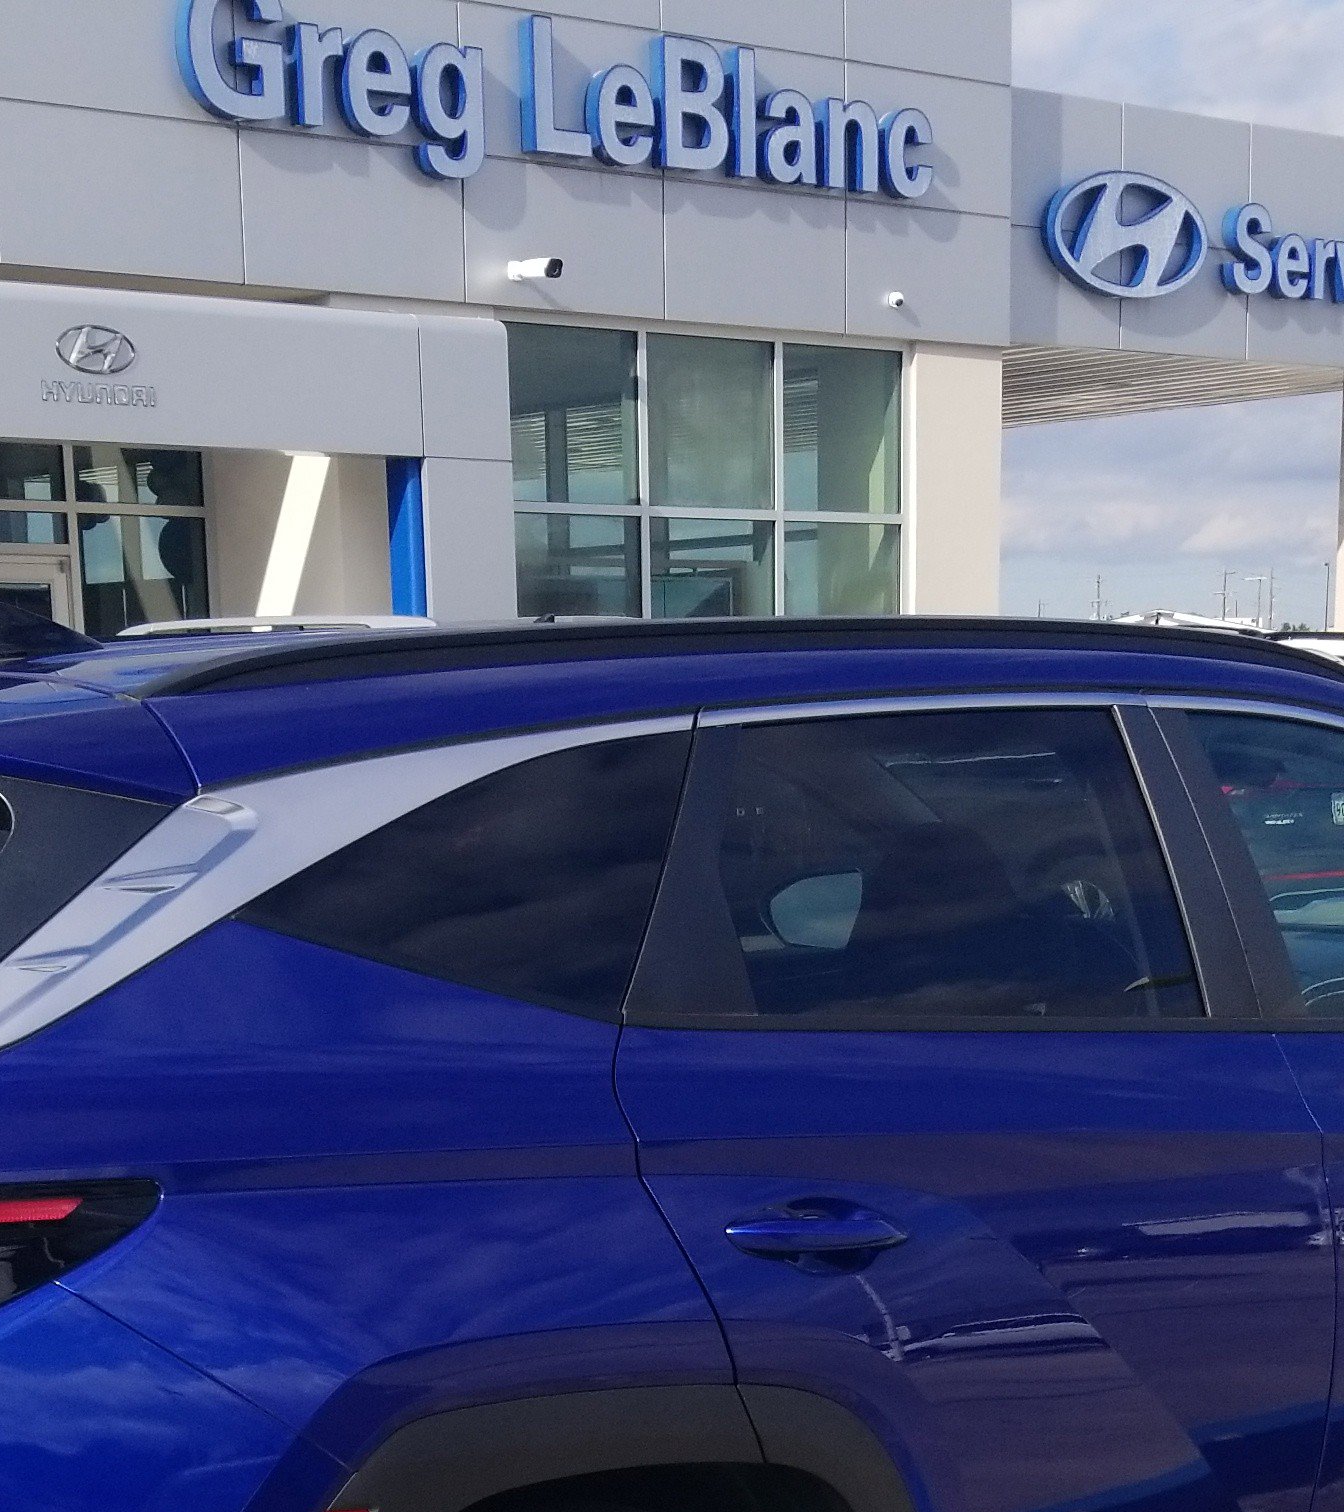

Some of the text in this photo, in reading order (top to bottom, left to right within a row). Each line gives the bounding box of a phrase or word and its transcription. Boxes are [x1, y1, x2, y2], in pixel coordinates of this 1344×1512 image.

[175, 0, 934, 200] Greg LeBlanc
[40, 379, 157, 408] HYUNDAI
